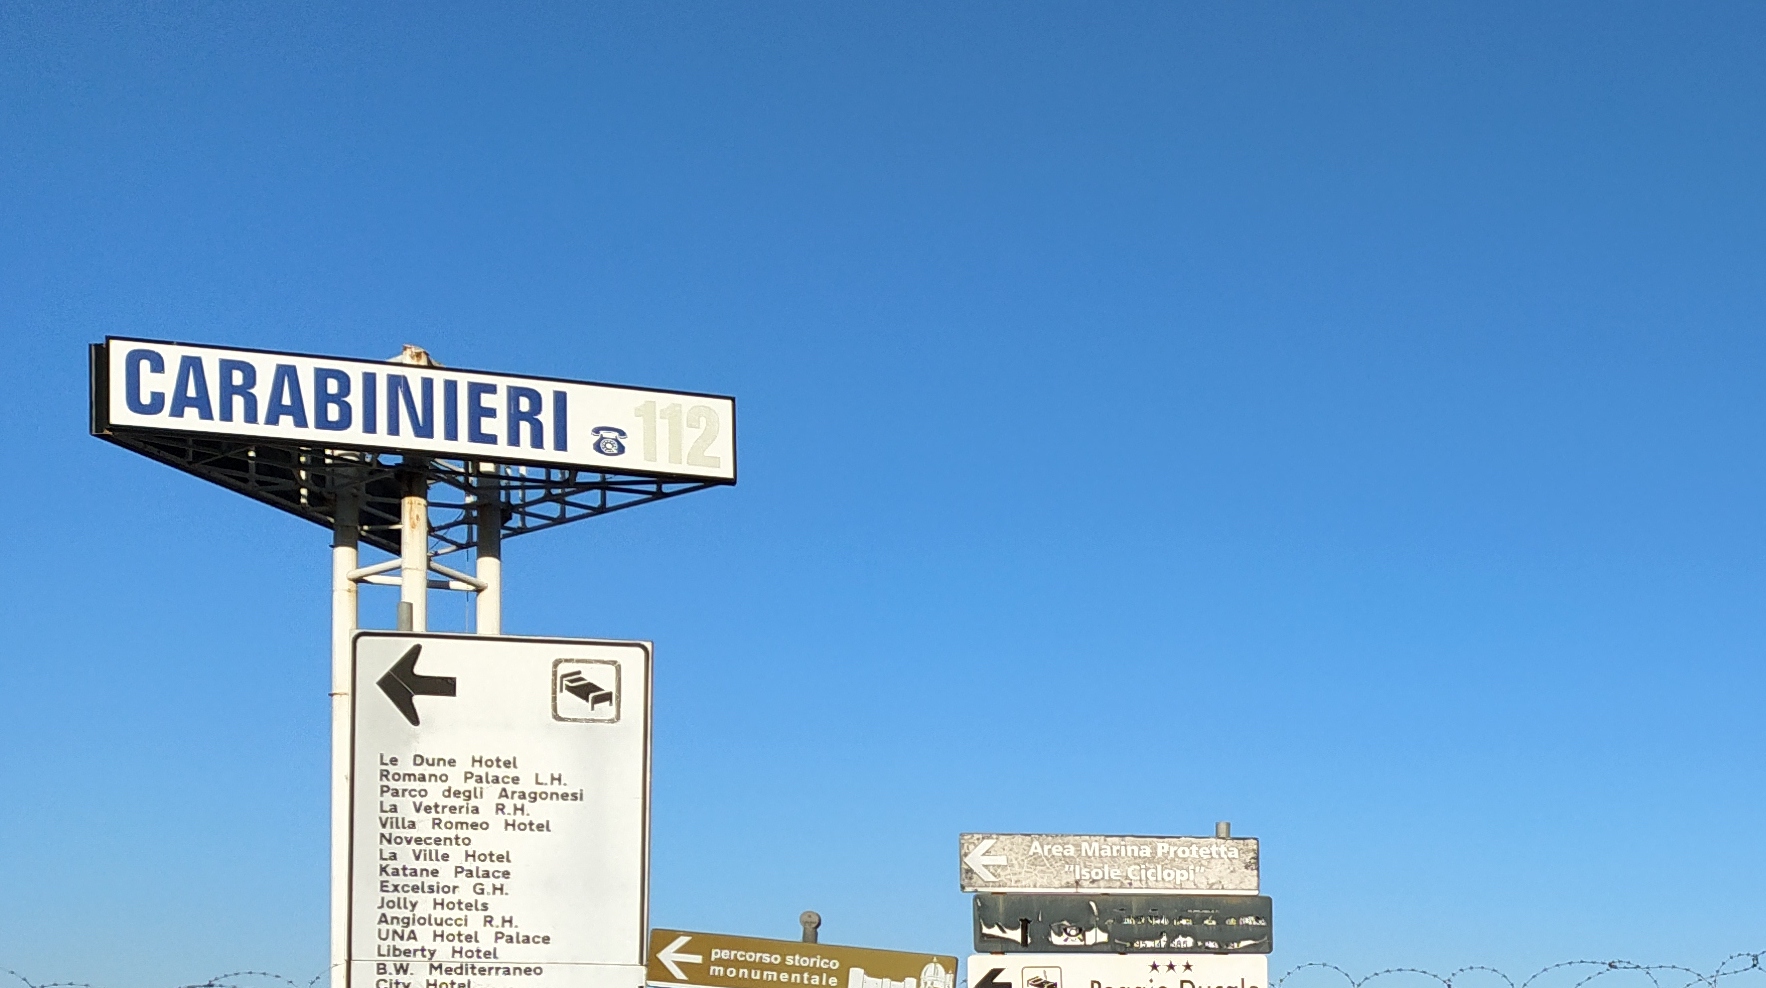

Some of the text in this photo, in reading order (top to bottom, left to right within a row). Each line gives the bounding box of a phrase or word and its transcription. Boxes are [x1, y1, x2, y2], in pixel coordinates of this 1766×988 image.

[125, 349, 720, 469] CARABINIERI 112
[380, 753, 517, 769] Le Dune Hotel
[380, 769, 567, 786] Romano Palace L.H.
[380, 785, 583, 803] Parco degli Aragonesi
[380, 801, 529, 816] La Vetreria R.H.
[379, 816, 551, 832] Villa Romeo Hotel
[379, 833, 471, 846] Novecento
[379, 848, 511, 863] La Ville Hotel
[1029, 841, 1239, 859] Area Marina Protetta
[379, 864, 510, 879] Katane Palace
[380, 880, 508, 895] Excelsior G.H.
[377, 897, 489, 912] Jolly Hotels
[377, 913, 518, 928] Angiolucci R.H.
[378, 928, 550, 944] UNA Hotel Palace
[377, 945, 498, 960] Liberty Hotel
[711, 948, 840, 970] percorso storico
[377, 963, 543, 977] B.W. Mediterraneo
[710, 964, 838, 986] monumentale
